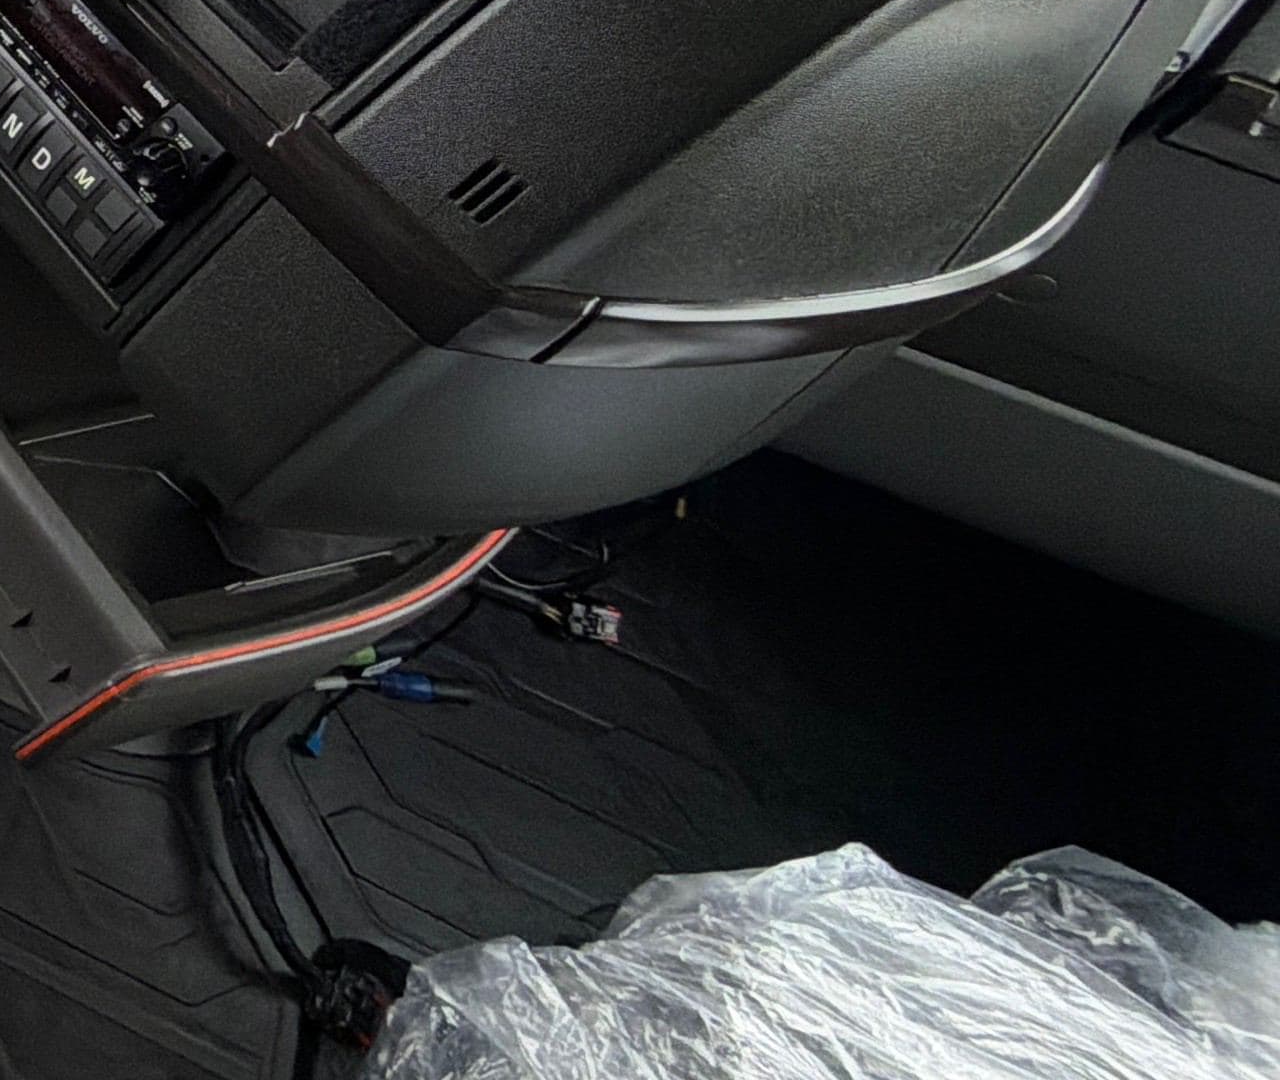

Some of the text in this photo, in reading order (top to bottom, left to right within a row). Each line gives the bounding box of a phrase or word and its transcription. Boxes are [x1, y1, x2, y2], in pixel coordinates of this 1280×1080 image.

[71, 3, 109, 45] VOLVO
[2, 113, 24, 139] N
[31, 147, 52, 171] D
[74, 167, 97, 190] M
